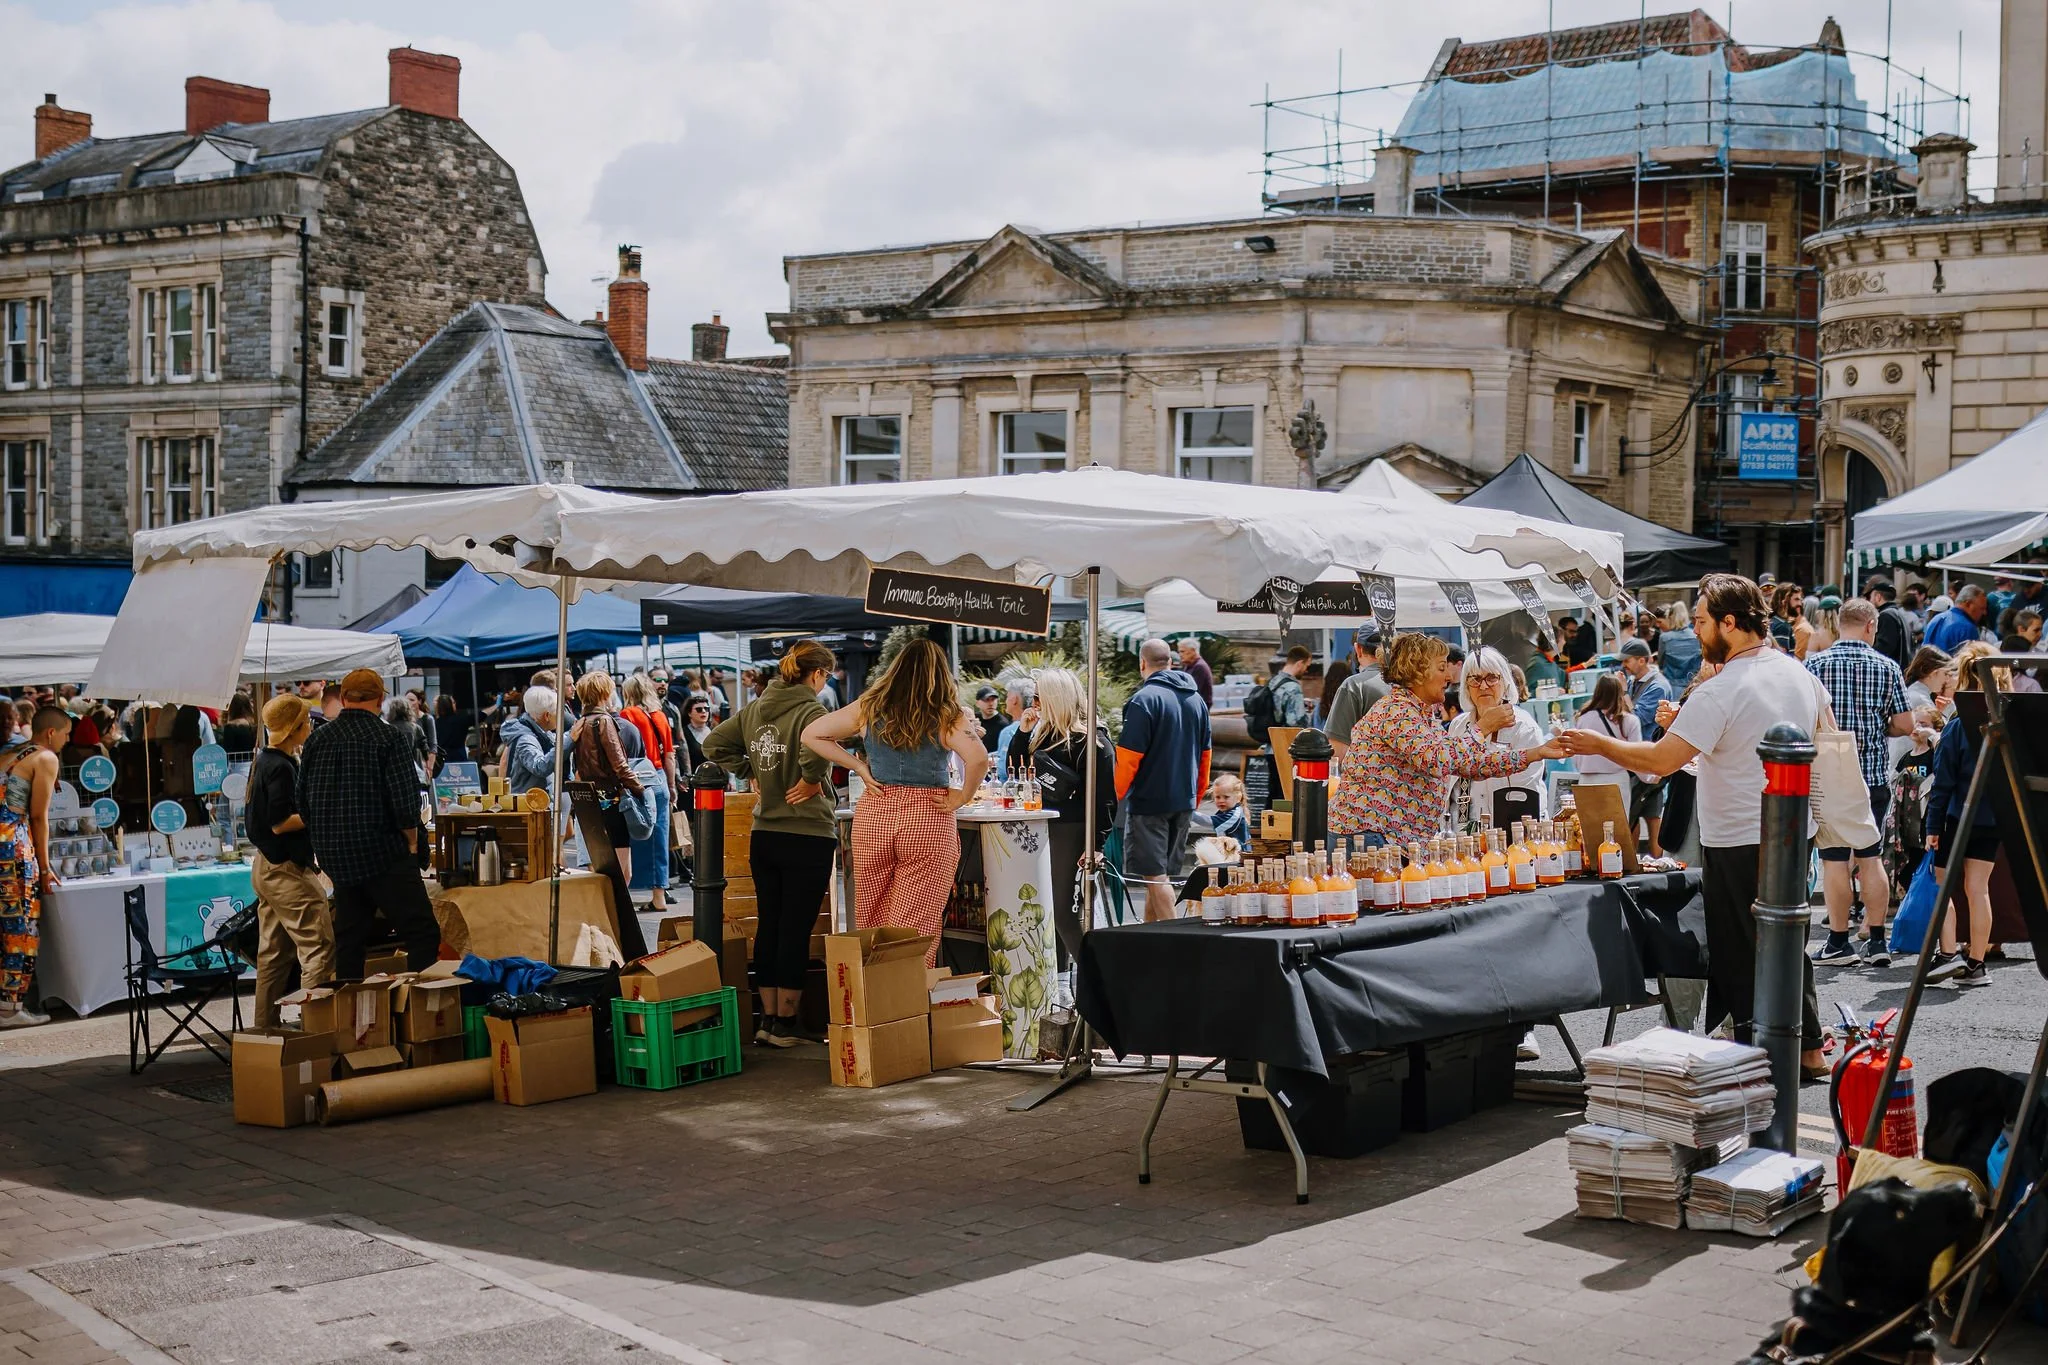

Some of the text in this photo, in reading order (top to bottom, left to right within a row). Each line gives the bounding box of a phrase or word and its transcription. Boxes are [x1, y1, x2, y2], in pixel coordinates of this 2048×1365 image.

[1744, 423, 1795, 440] APEX
[1742, 441, 1797, 453] Scaffolding
[1271, 577, 1298, 593] taste
[883, 579, 1031, 617] Immune Boosting Health Tonic
[1371, 597, 1395, 610] taste
[1523, 598, 1543, 609] taste
[1454, 603, 1478, 614] taste
